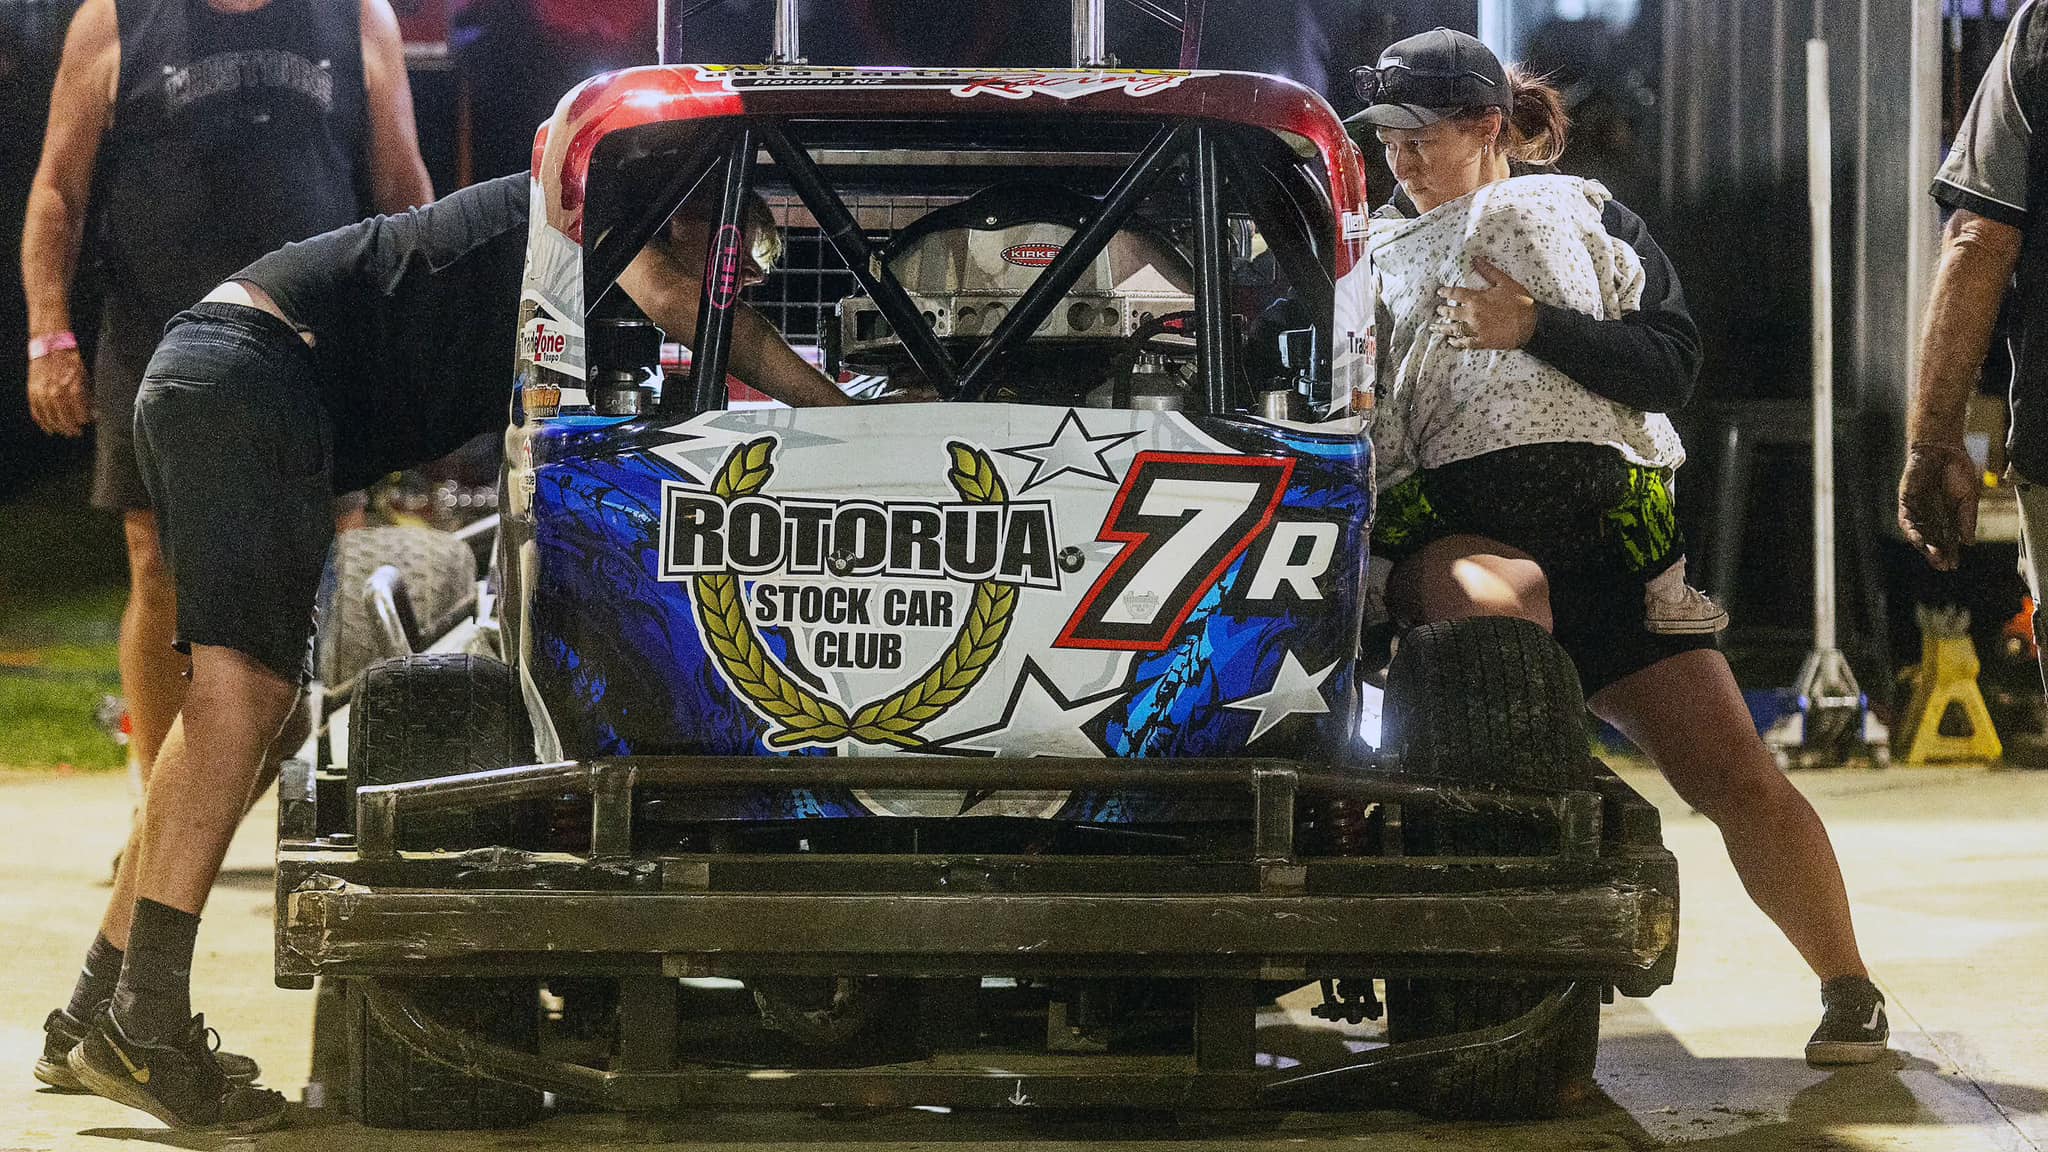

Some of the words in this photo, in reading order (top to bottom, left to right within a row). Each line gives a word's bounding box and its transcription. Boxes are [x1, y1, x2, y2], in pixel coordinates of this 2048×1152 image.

[961, 73, 1176, 94] Racing
[1010, 249, 1060, 258] KIRKE
[670, 494, 1056, 582] ROTORUA
[1063, 462, 1286, 640] 7
[755, 584, 871, 625] STOCK
[883, 588, 953, 628] CAR
[814, 630, 902, 670] CLUB
